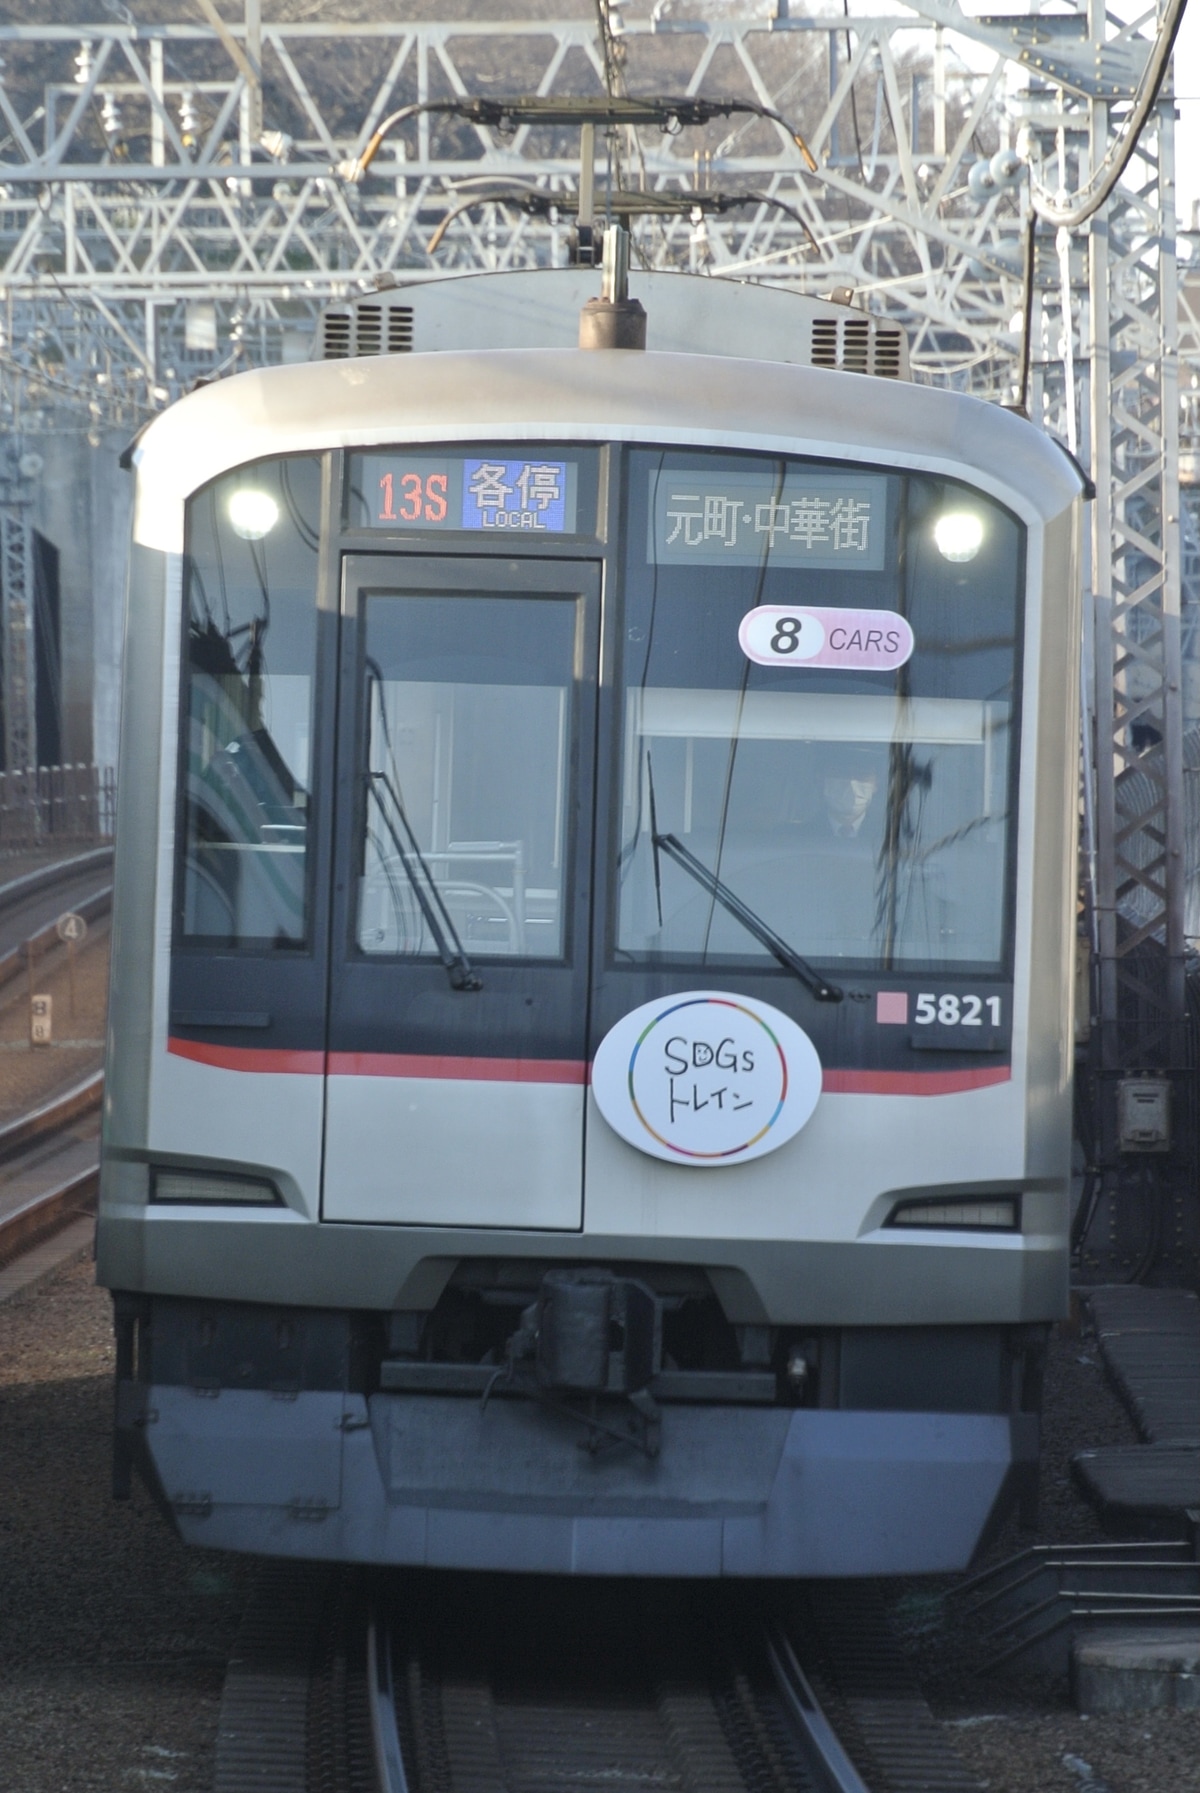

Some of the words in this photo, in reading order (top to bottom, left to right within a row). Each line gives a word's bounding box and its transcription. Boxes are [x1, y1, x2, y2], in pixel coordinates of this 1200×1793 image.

[378, 473, 448, 522] 13S
[468, 461, 561, 511] 各停
[481, 511, 546, 530] LOCAL
[769, 617, 803, 654] 8
[828, 627, 901, 654] CARS
[914, 993, 1001, 1026] 5821
[663, 1036, 755, 1076] SDGs
[670, 1077, 753, 1123] トレイン
